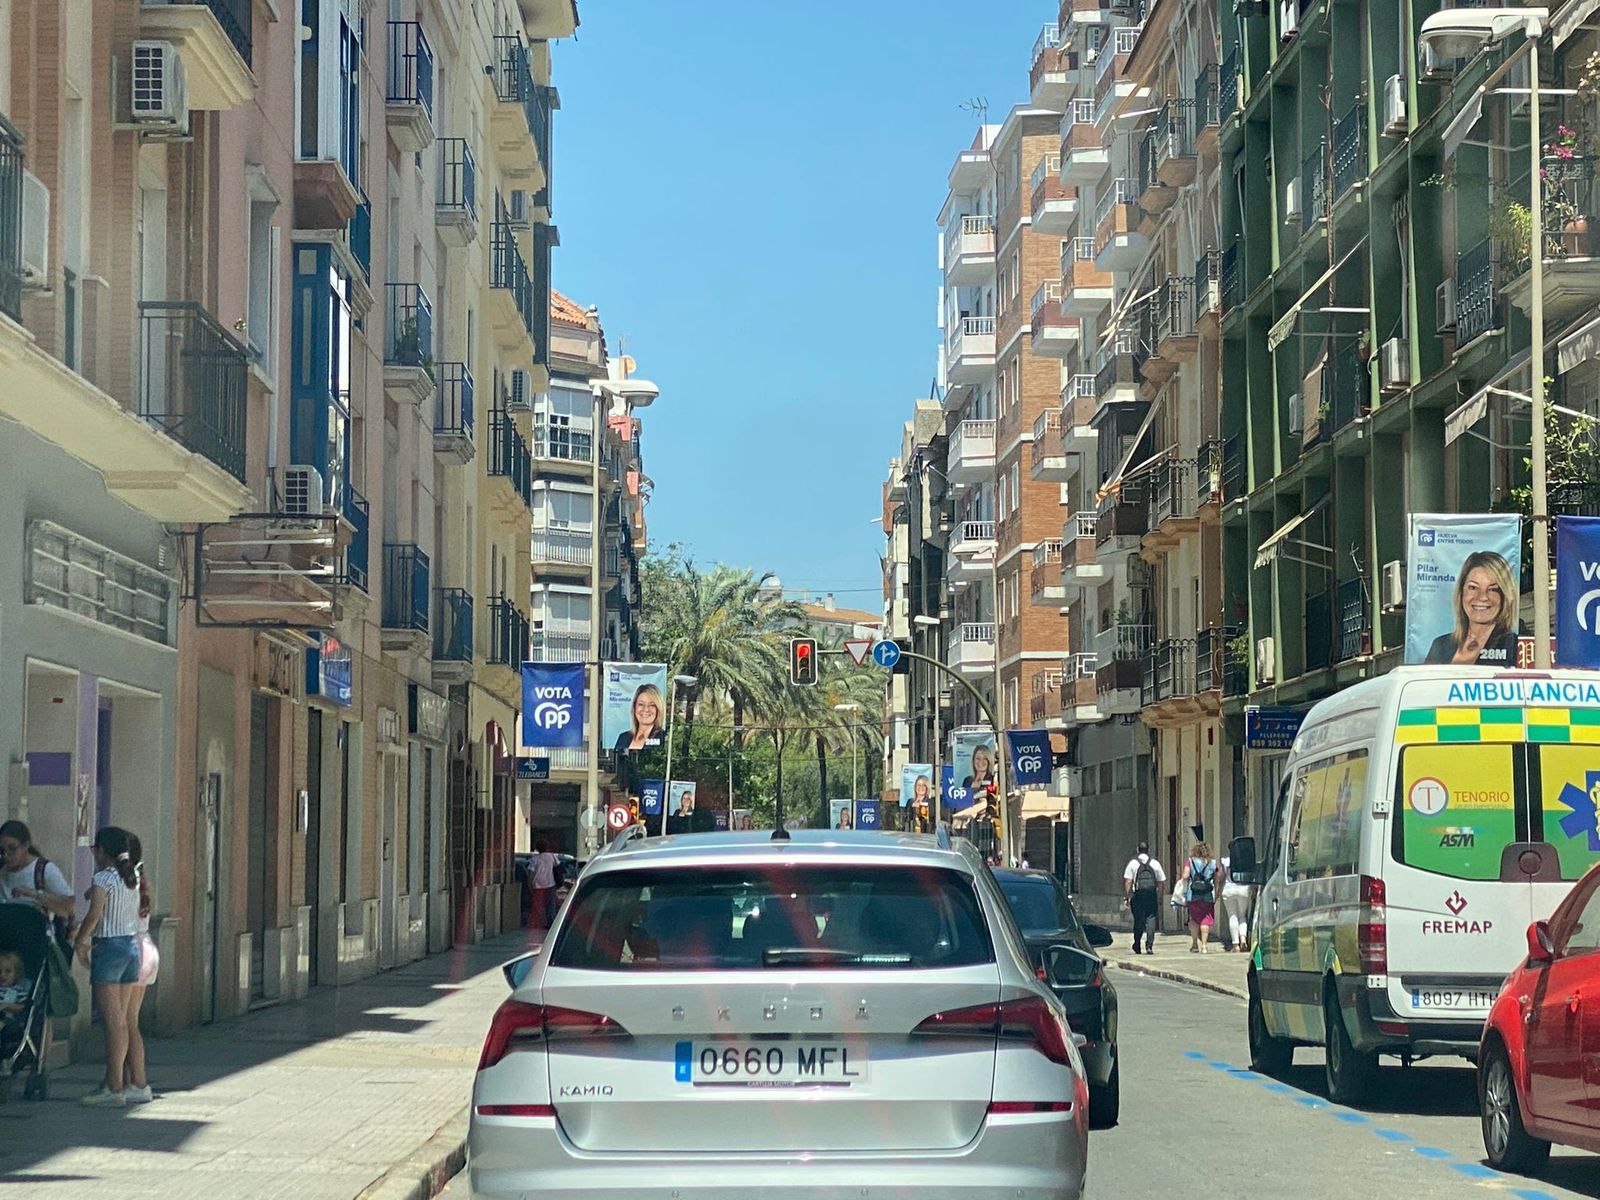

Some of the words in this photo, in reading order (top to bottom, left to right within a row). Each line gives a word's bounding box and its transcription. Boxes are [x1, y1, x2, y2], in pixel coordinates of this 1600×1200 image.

[1417, 564, 1438, 572] Pilar
[1416, 573, 1456, 582] Miranda
[1480, 649, 1507, 660] 28M
[534, 687, 572, 699] VOTA
[1448, 682, 1600, 703] AMBULANCIA
[1017, 745, 1041, 754] VOTA
[1454, 791, 1510, 803] TENORIO
[1439, 834, 1475, 848] ASM
[1422, 920, 1493, 935] FREMAP
[1423, 992, 1462, 1006] 8097
[700, 1047, 783, 1076] 0660
[798, 1047, 860, 1077] MFL
[560, 1085, 614, 1097] KAMIQ
